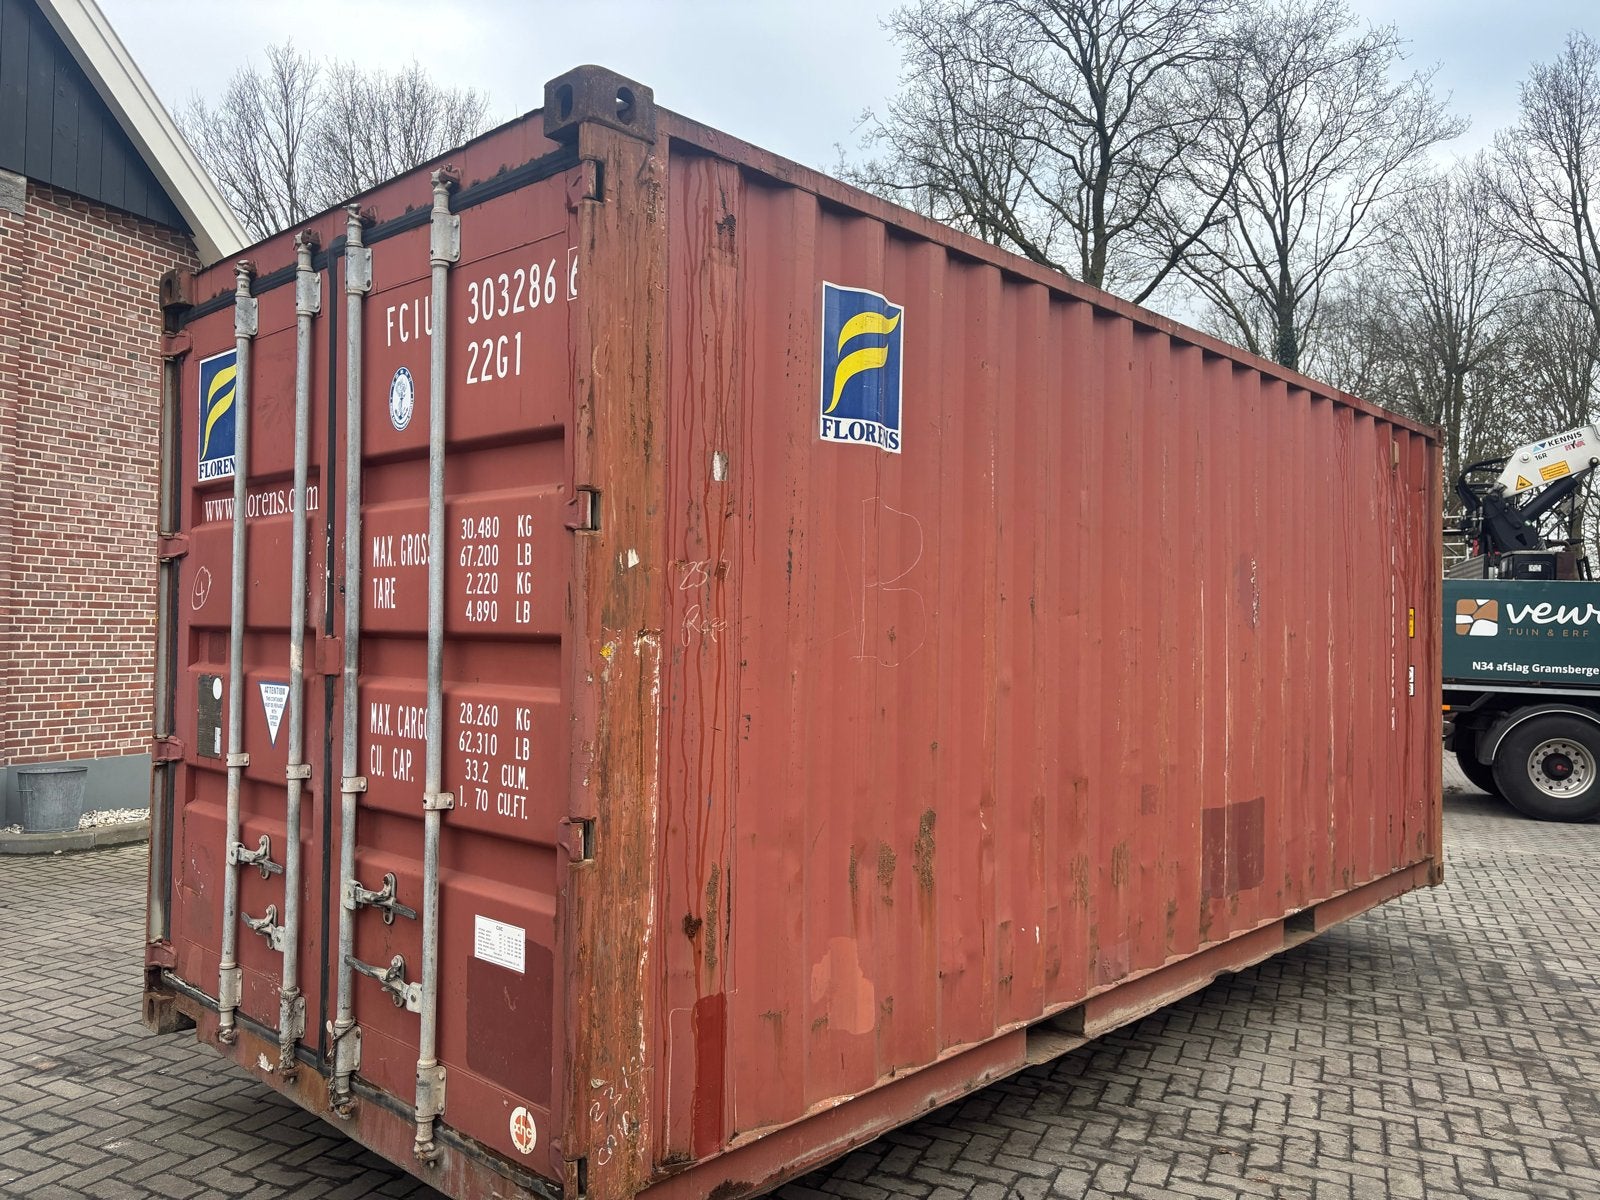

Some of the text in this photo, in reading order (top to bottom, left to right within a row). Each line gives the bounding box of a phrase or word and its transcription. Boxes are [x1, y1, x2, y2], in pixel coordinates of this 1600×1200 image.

[467, 258, 556, 324] 303286
[466, 331, 521, 384] 22G1
[821, 417, 899, 450] FLORENS
[1547, 431, 1582, 447] KENNIS
[199, 457, 235, 479] FLOREN
[461, 514, 532, 540] 30,480 KG
[373, 535, 397, 567] MAX.
[460, 543, 532, 567] 67,200 LB
[373, 577, 396, 609] TARE
[466, 571, 532, 595] 2,220 KG
[466, 600, 531, 623] 4,890 LB
[1507, 627, 1589, 637] TUIN & ERF
[1472, 661, 1494, 671] N34
[1496, 662, 1530, 674] afslag
[370, 702, 394, 736] MAX.
[459, 702, 531, 732] 28,260 KG
[459, 730, 530, 761] 62,310 LB
[370, 744, 414, 782] CU. CAP.
[465, 758, 489, 784] 33.2
[497, 792, 528, 820] CU.FT.
